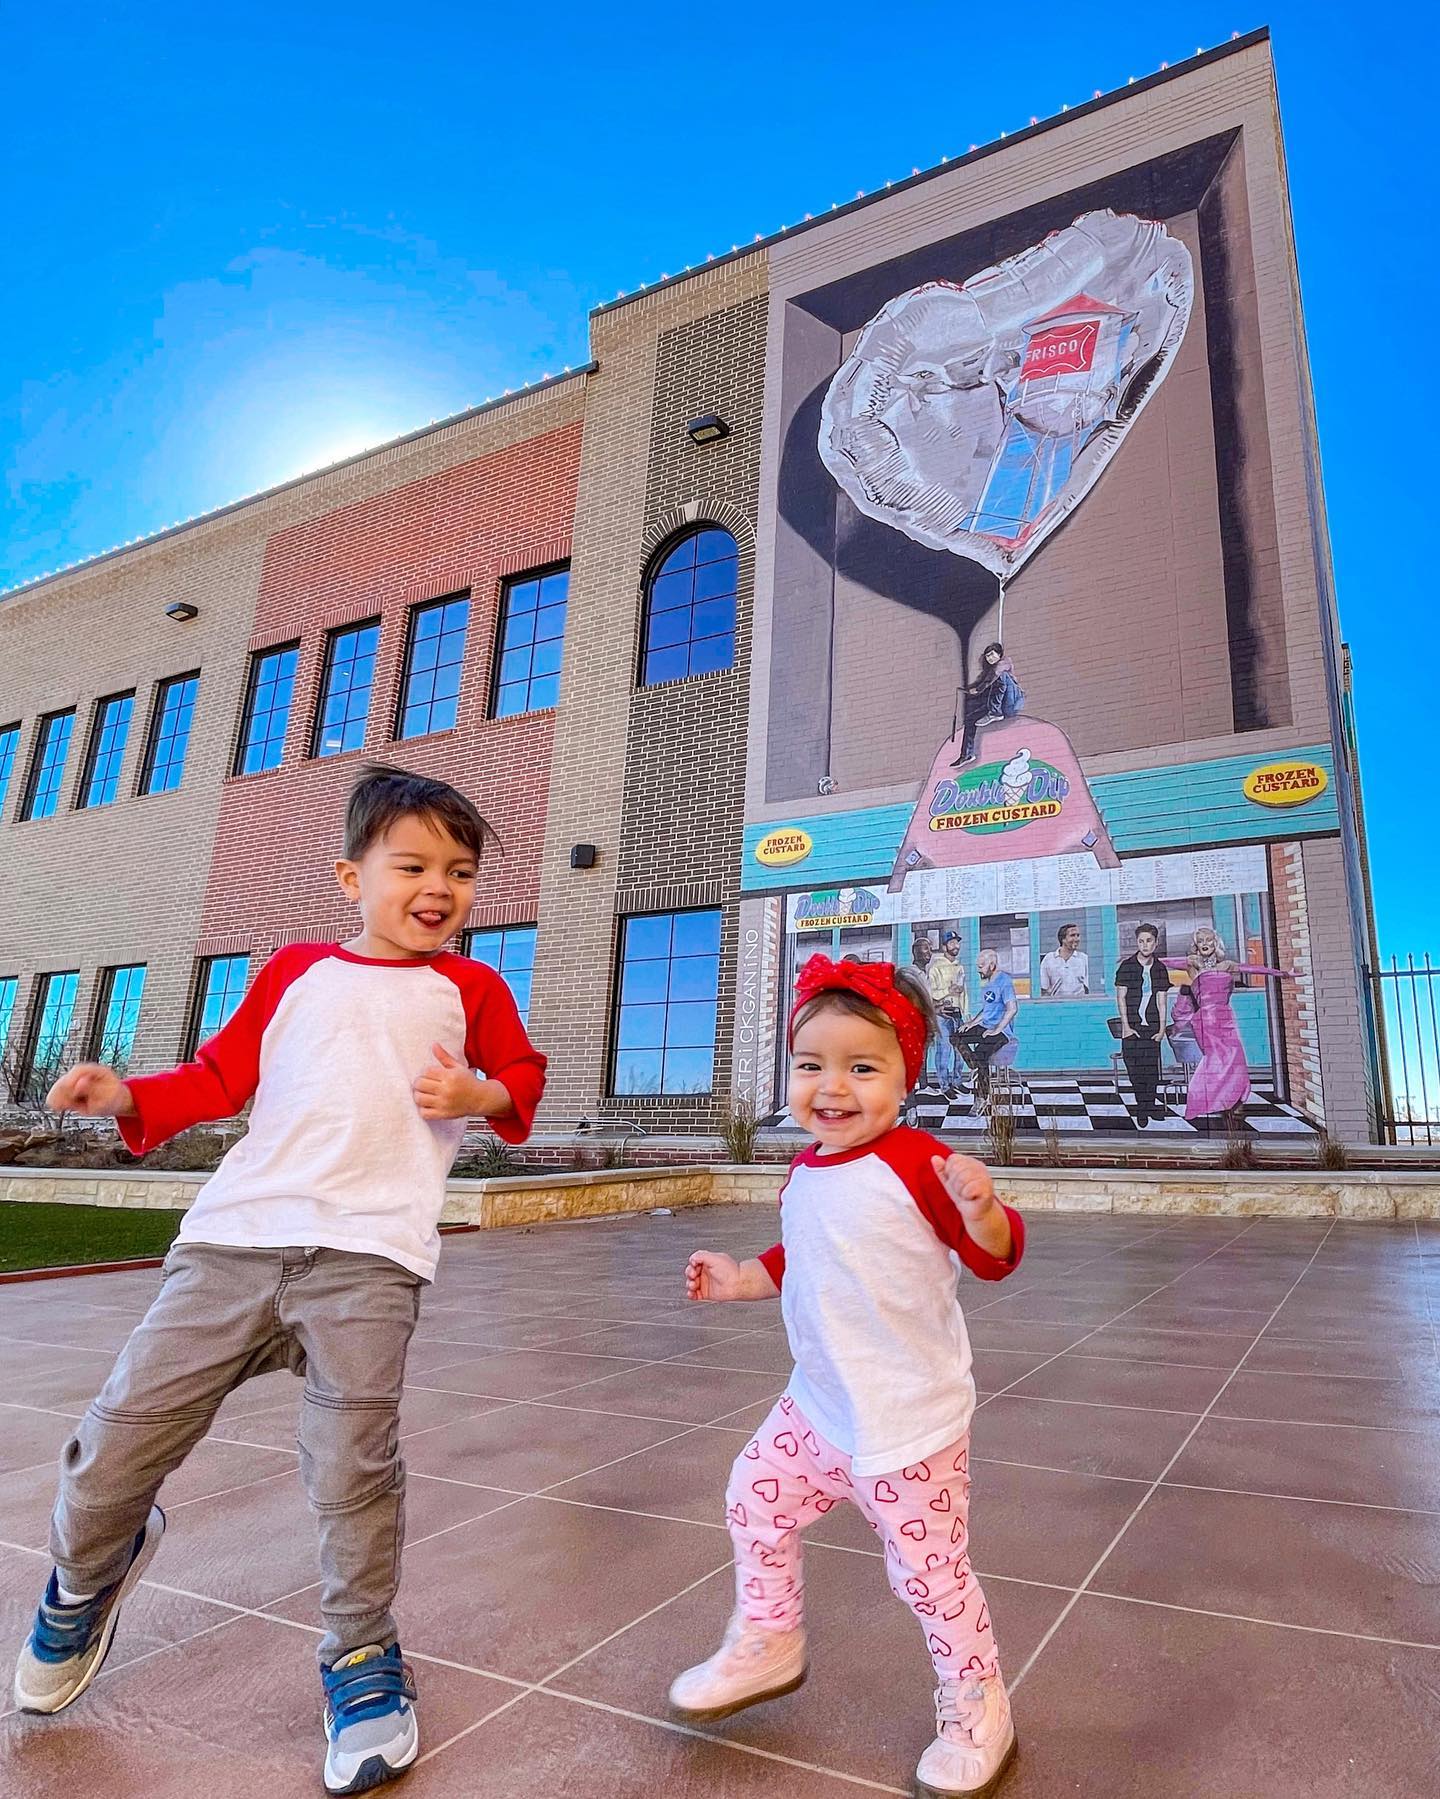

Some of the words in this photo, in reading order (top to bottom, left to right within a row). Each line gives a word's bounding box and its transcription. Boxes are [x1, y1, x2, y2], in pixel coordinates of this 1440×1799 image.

[1025, 339, 1078, 362] FRISCO
[1256, 767, 1316, 784] FROZEN
[929, 778, 1006, 816] Double
[1027, 767, 1071, 803] Dip
[1252, 777, 1320, 794] CUSTARD
[936, 812, 989, 830] FROZEN
[992, 803, 1057, 822] CUSTARD
[763, 843, 806, 855] CUSTARD
[766, 834, 803, 847] FROZEN
[800, 916, 831, 928] FROZEN
[832, 914, 869, 925] CUSTARD
